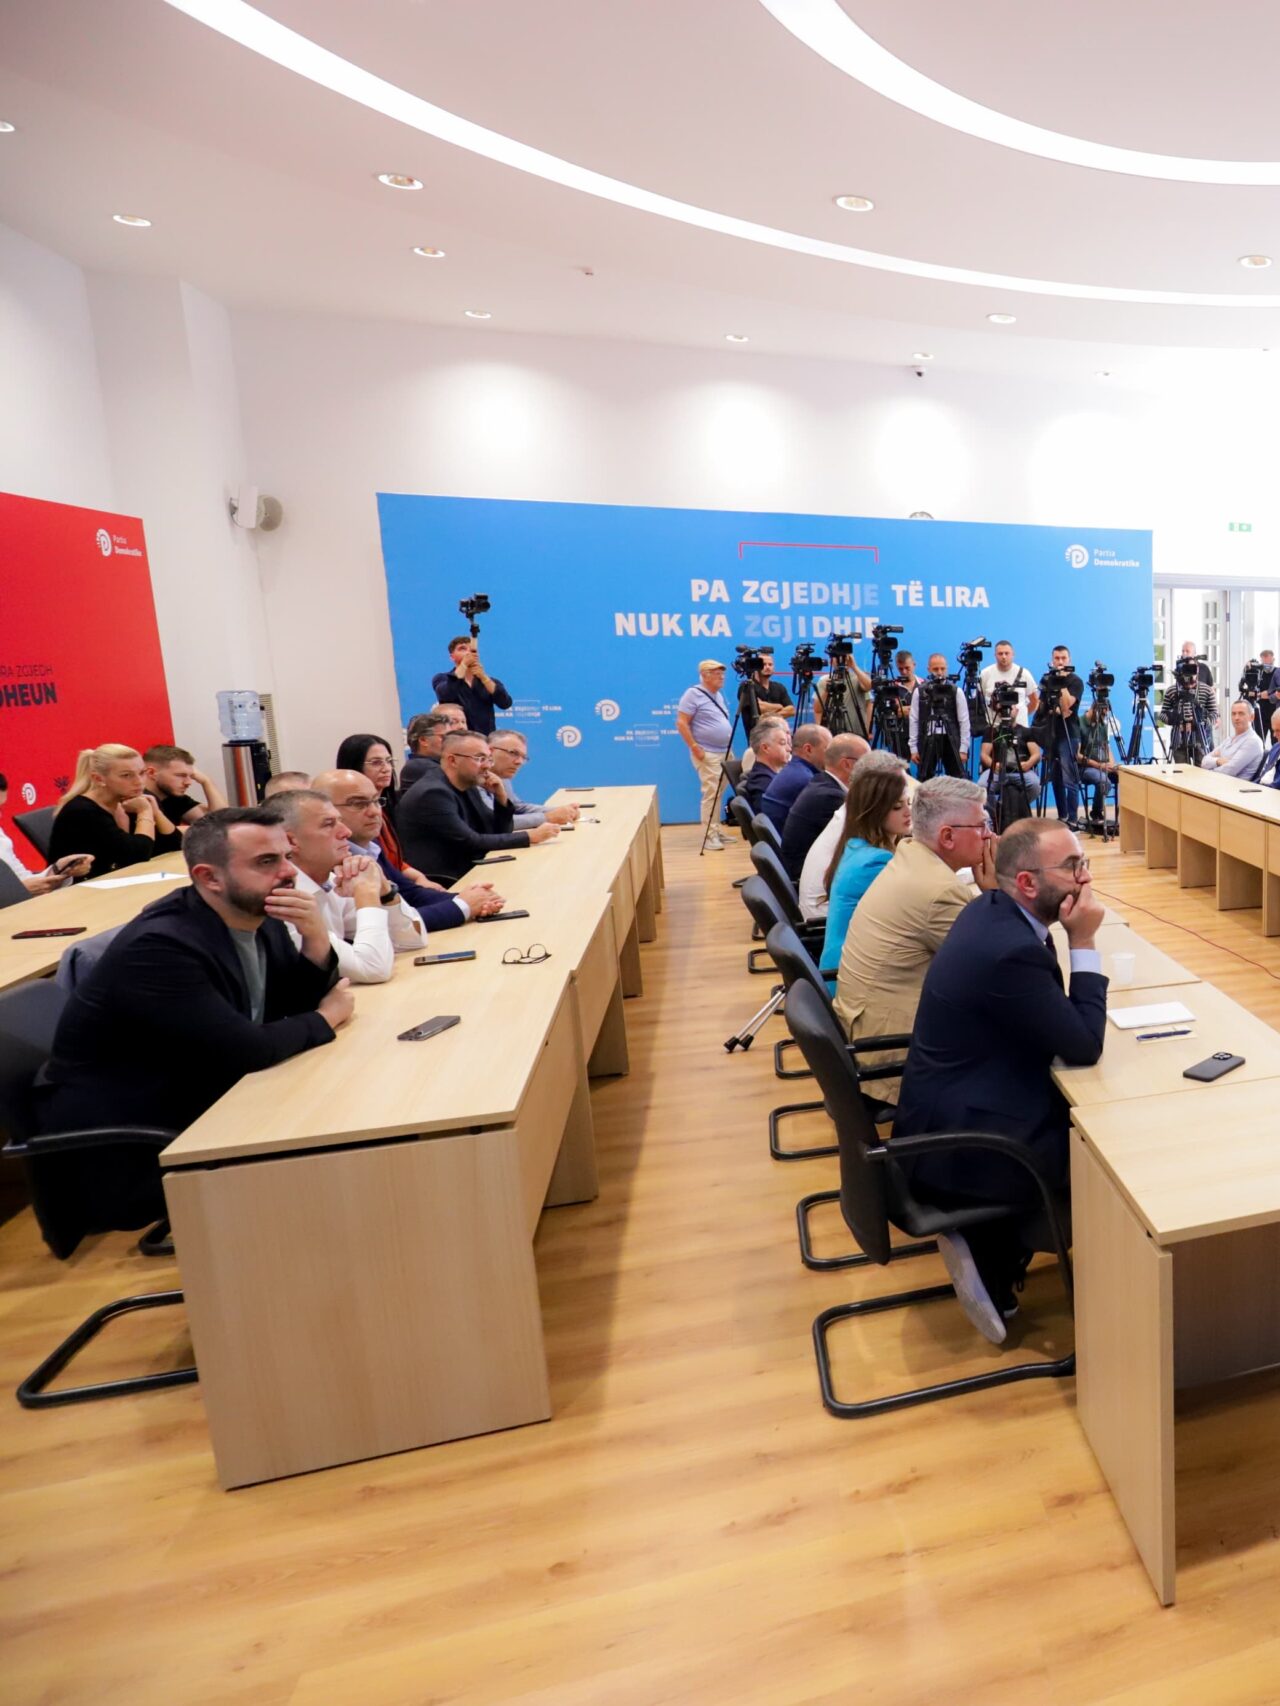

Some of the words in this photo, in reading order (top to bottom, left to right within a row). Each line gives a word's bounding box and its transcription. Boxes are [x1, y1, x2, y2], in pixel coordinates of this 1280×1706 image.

[690, 578, 730, 602] PA
[742, 580, 880, 610] ZGJEDHJE
[891, 580, 924, 607] TË
[930, 585, 990, 608] LIRA
[614, 612, 683, 636] NUK
[690, 613, 732, 637] KA
